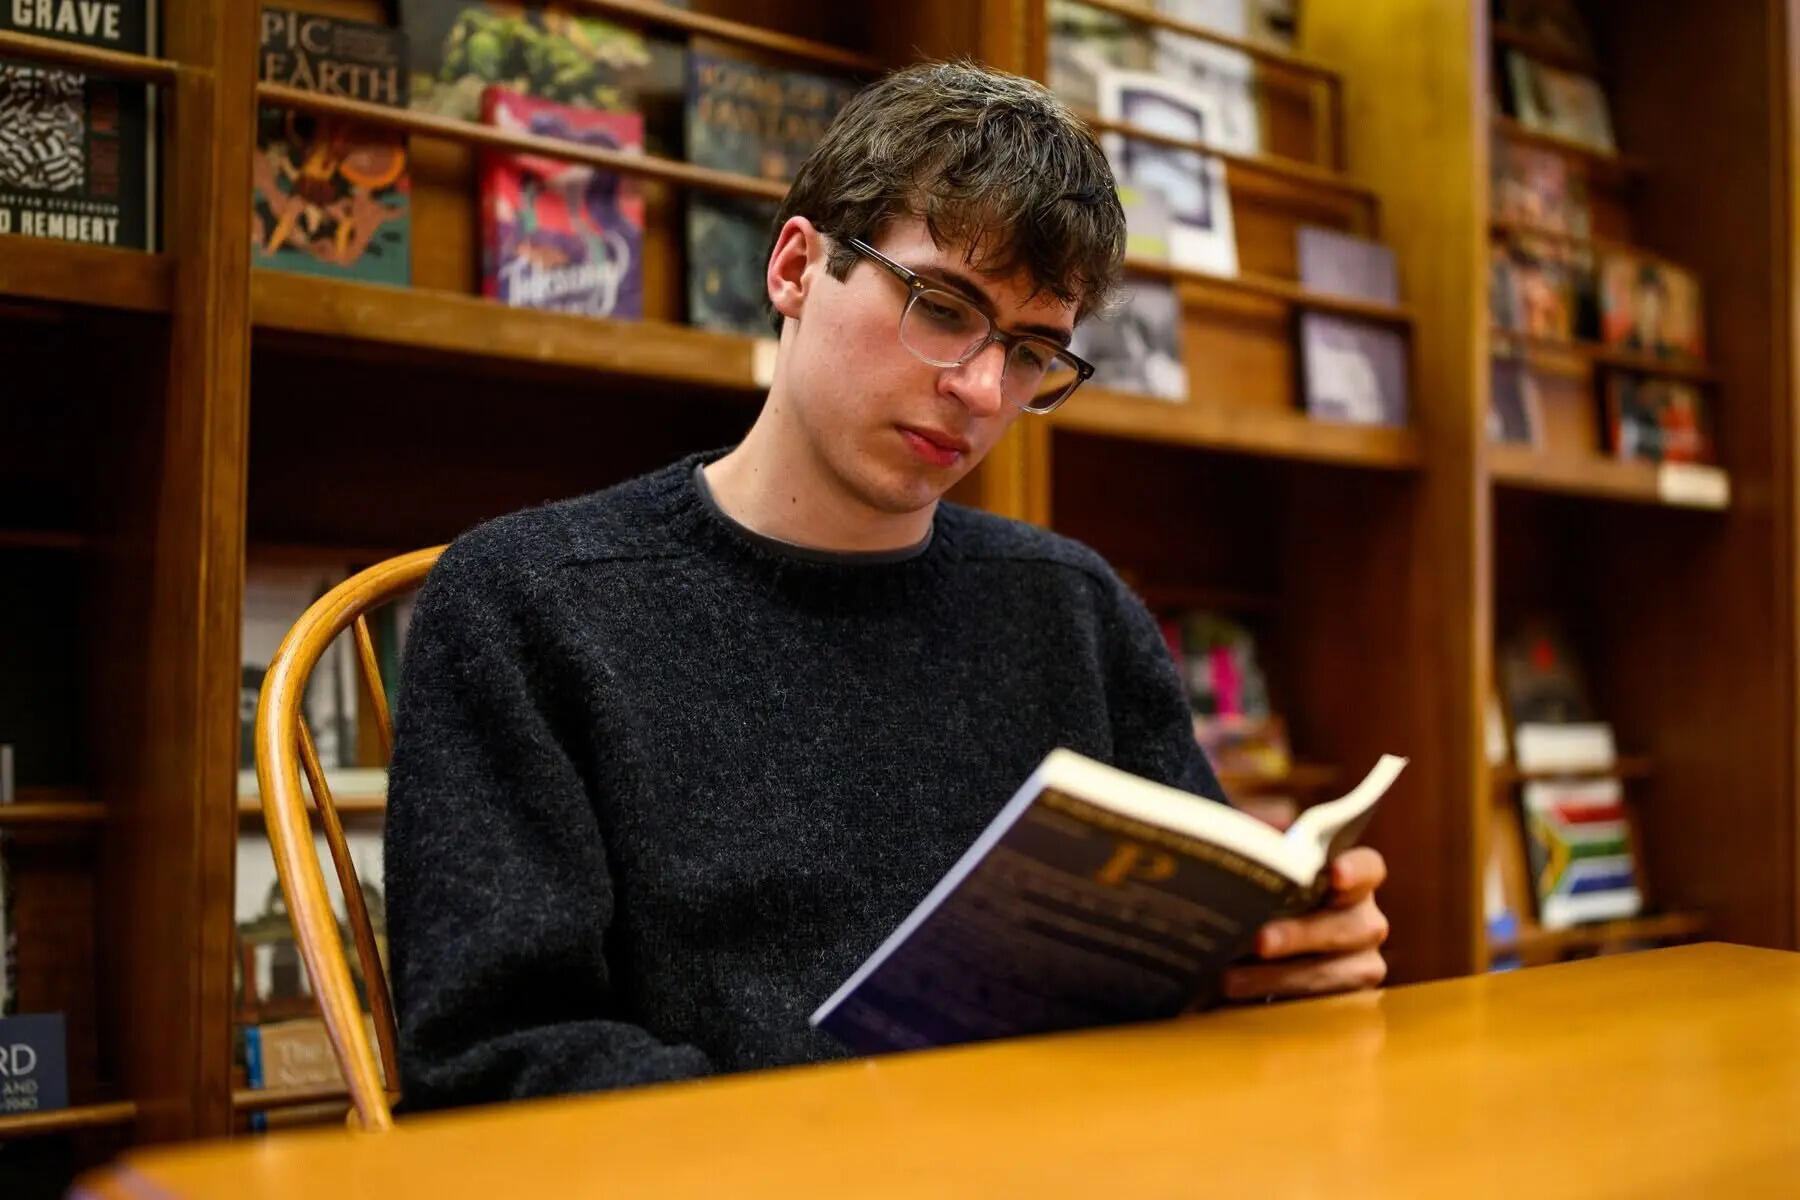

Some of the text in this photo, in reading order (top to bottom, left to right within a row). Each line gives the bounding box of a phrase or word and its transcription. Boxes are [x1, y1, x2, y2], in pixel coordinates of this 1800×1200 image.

[12, 0, 120, 39] GRAVE
[265, 49, 398, 105] EARTH
[21, 210, 118, 245] REMBERT
